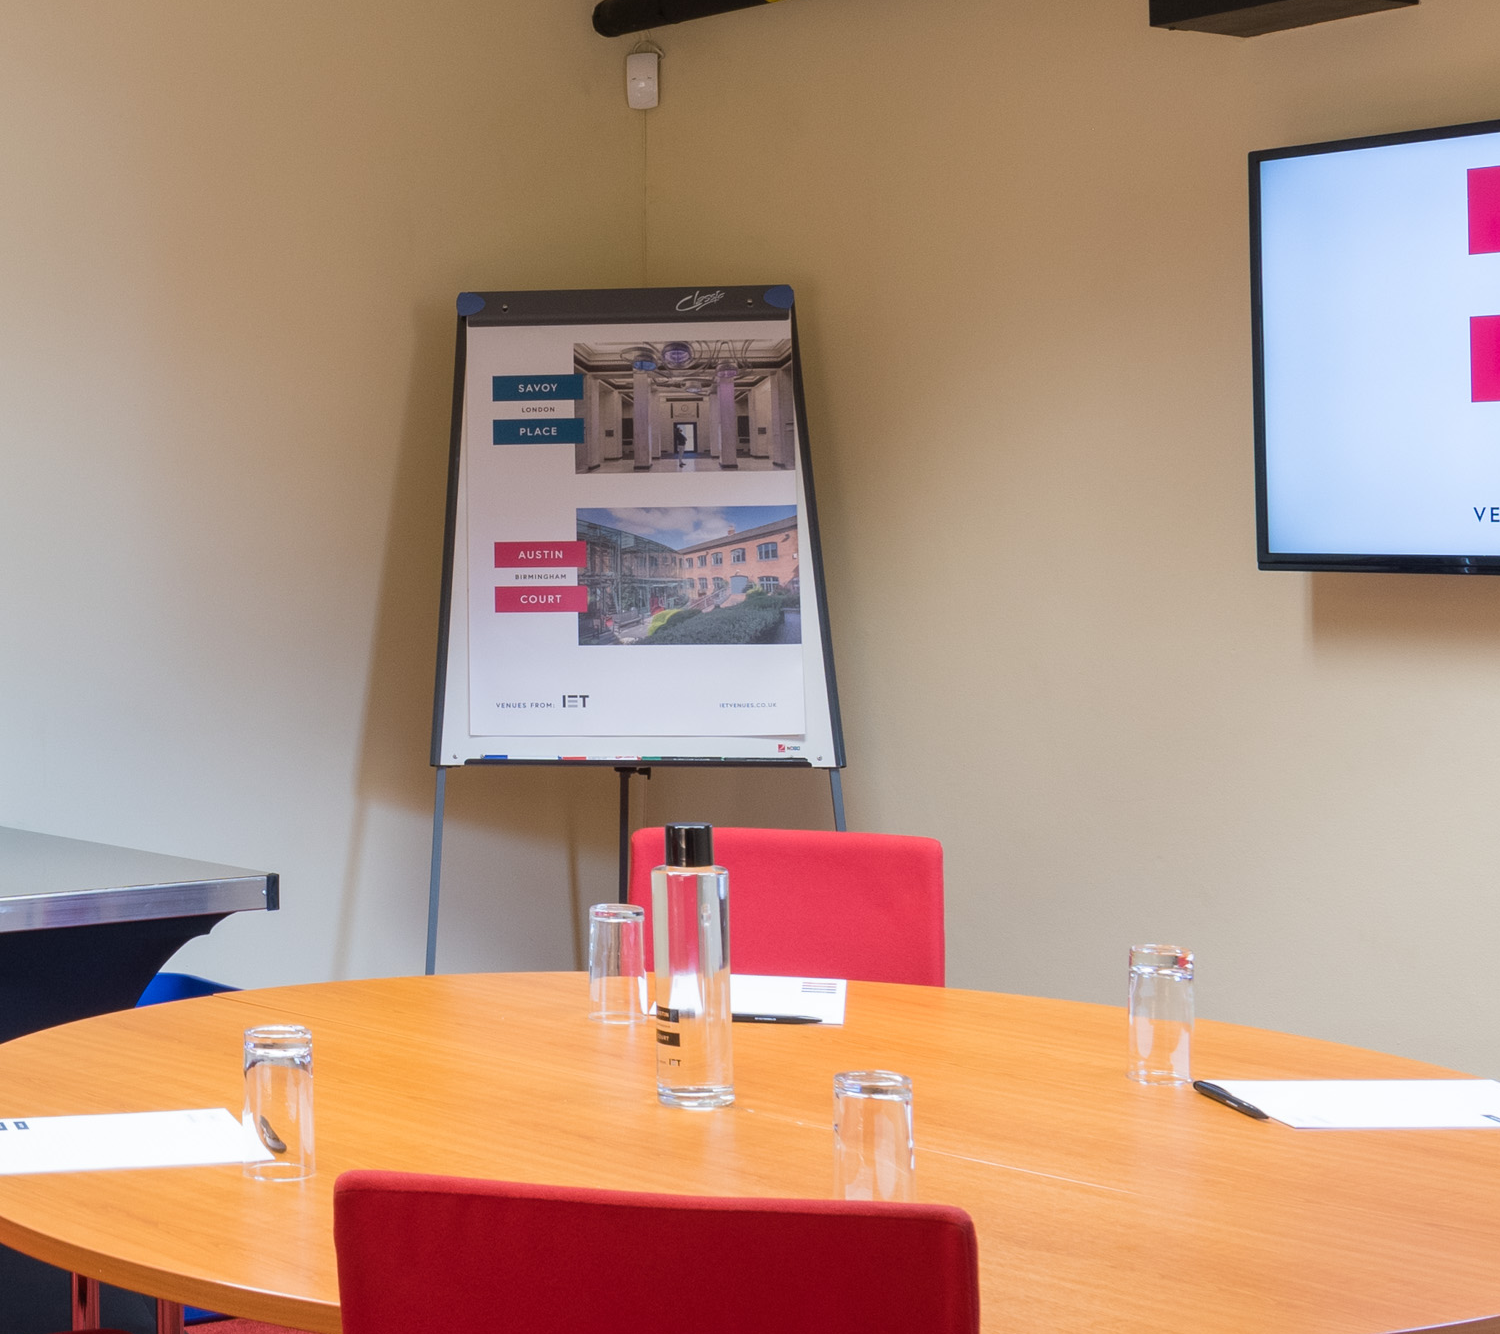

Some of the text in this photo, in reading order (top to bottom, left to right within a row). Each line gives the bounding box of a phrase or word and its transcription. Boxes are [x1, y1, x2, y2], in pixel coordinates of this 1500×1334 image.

[518, 383, 558, 393] SAVOY
[519, 427, 557, 436] PLACE
[518, 550, 563, 559] AUSTIN
[520, 595, 562, 604] COURT
[562, 695, 589, 708] IET
